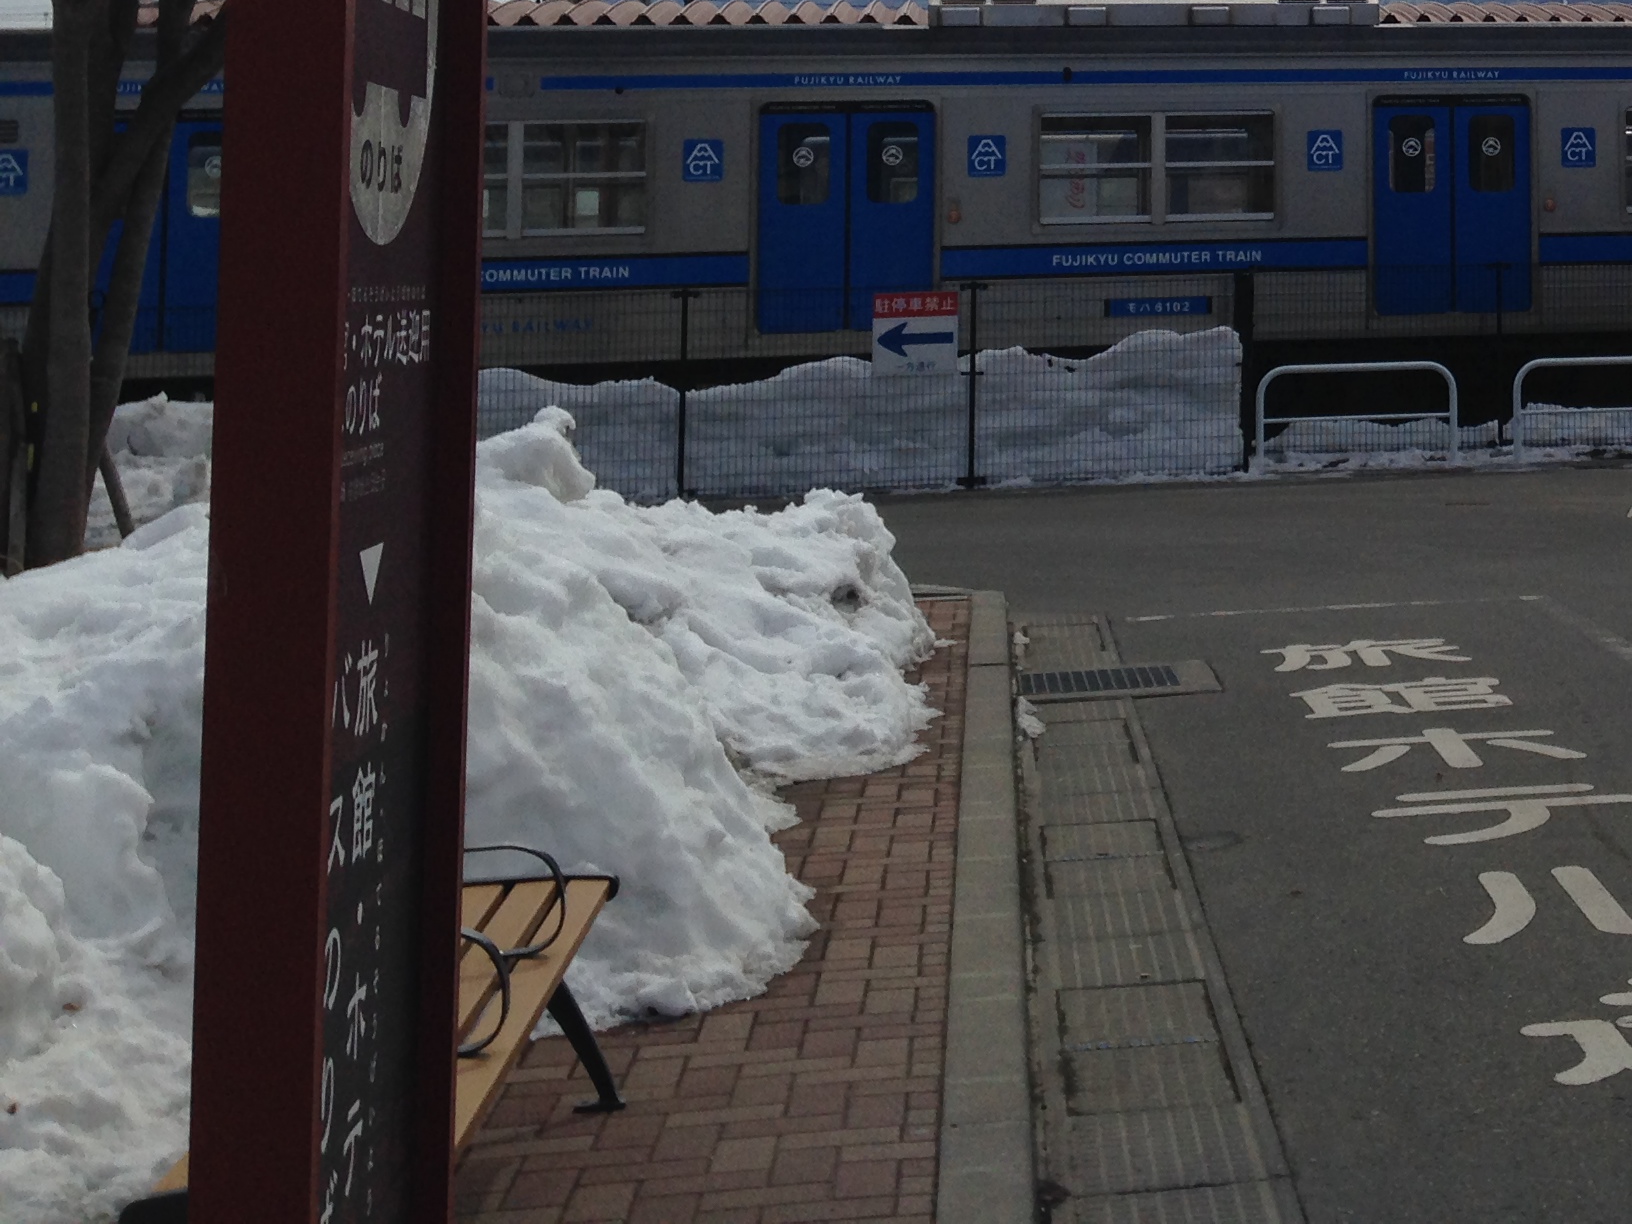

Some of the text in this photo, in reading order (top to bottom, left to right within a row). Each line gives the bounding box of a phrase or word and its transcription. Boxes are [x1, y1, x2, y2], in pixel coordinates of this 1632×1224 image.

[794, 75, 901, 85] FUJIKYU RAILWAY
[1403, 70, 1500, 80] FUJIKYU RAILWAY
[360, 139, 403, 194] のりば
[1052, 250, 1262, 267] FUJIKYU COMMUTER TRAIN
[578, 265, 629, 279] TRAIN
[875, 296, 954, 314] 駐停車禁止
[344, 309, 431, 370] ・ホテル送迎用
[342, 372, 383, 435] のりば
